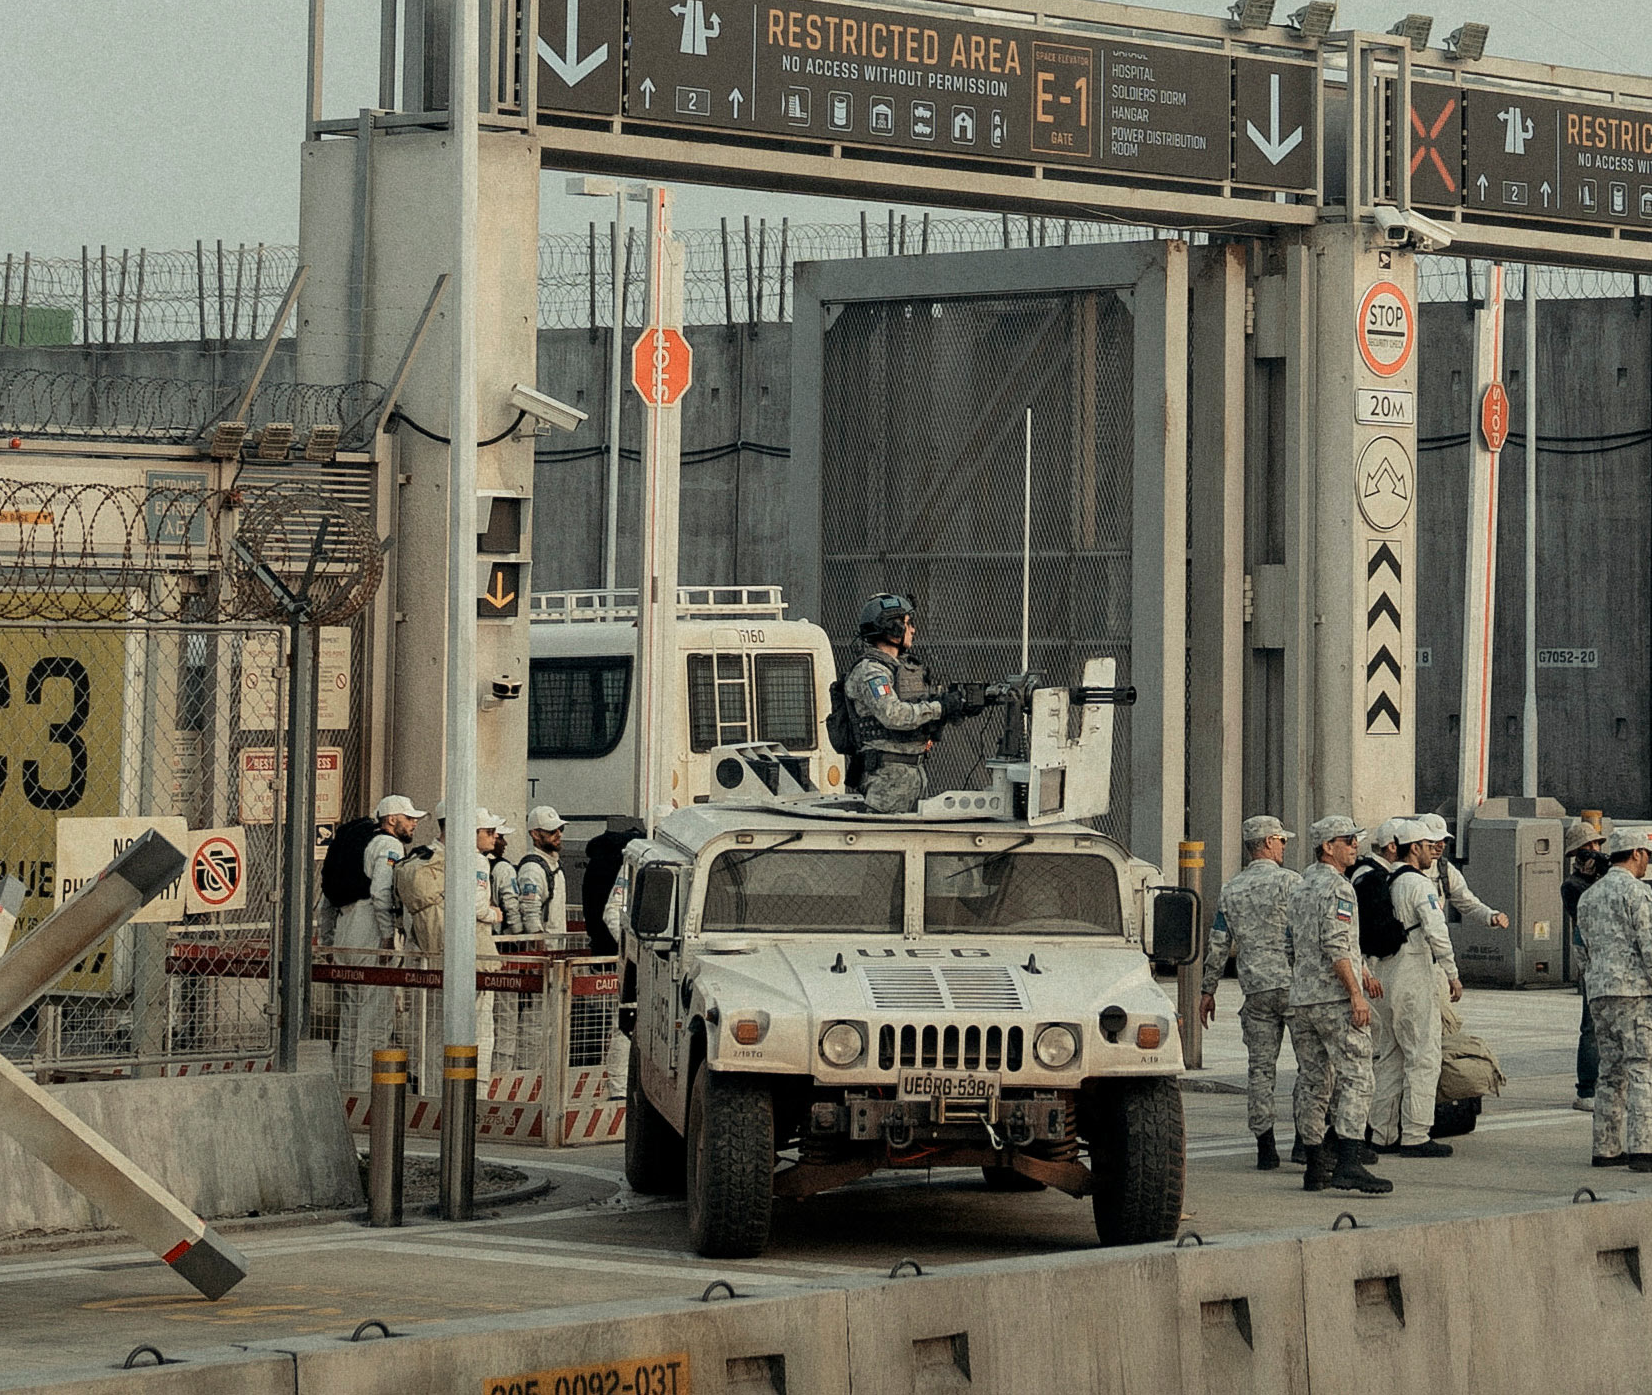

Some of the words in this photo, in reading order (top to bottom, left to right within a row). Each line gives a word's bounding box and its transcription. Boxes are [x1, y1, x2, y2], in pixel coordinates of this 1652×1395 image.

[768, 8, 940, 66] RESTRICTED
[950, 32, 1022, 76] AREA
[782, 55, 801, 72] NO
[805, 57, 859, 80] ACCESS
[863, 64, 923, 88] WITHOUT
[927, 73, 1008, 98] PERMISSION
[1112, 63, 1155, 82] HOSPITAL
[687, 93, 698, 111] 2
[1036, 71, 1087, 127] E-1
[1160, 89, 1187, 106] DORM
[1112, 105, 1149, 123] HANGAR
[1050, 131, 1074, 147] GATE
[1112, 126, 1145, 144] POWER
[1147, 130, 1207, 151] DISTRIBUTION
[1112, 141, 1138, 157] ROOM
[1578, 152, 1592, 168] NO
[1595, 155, 1635, 173] ACCESS
[1511, 185, 1519, 201] 2
[1369, 304, 1404, 328] STOP
[652, 331, 671, 402] STOP
[1491, 386, 1501, 447] STOP
[1538, 650, 1596, 664] G7052-20
[19, 859, 54, 898] UE
[857, 947, 991, 958] UEG
[331, 968, 365, 981] CAUTION
[404, 972, 441, 985] CAUTION
[484, 976, 522, 989] CAUTION
[595, 977, 618, 991] CAUT
